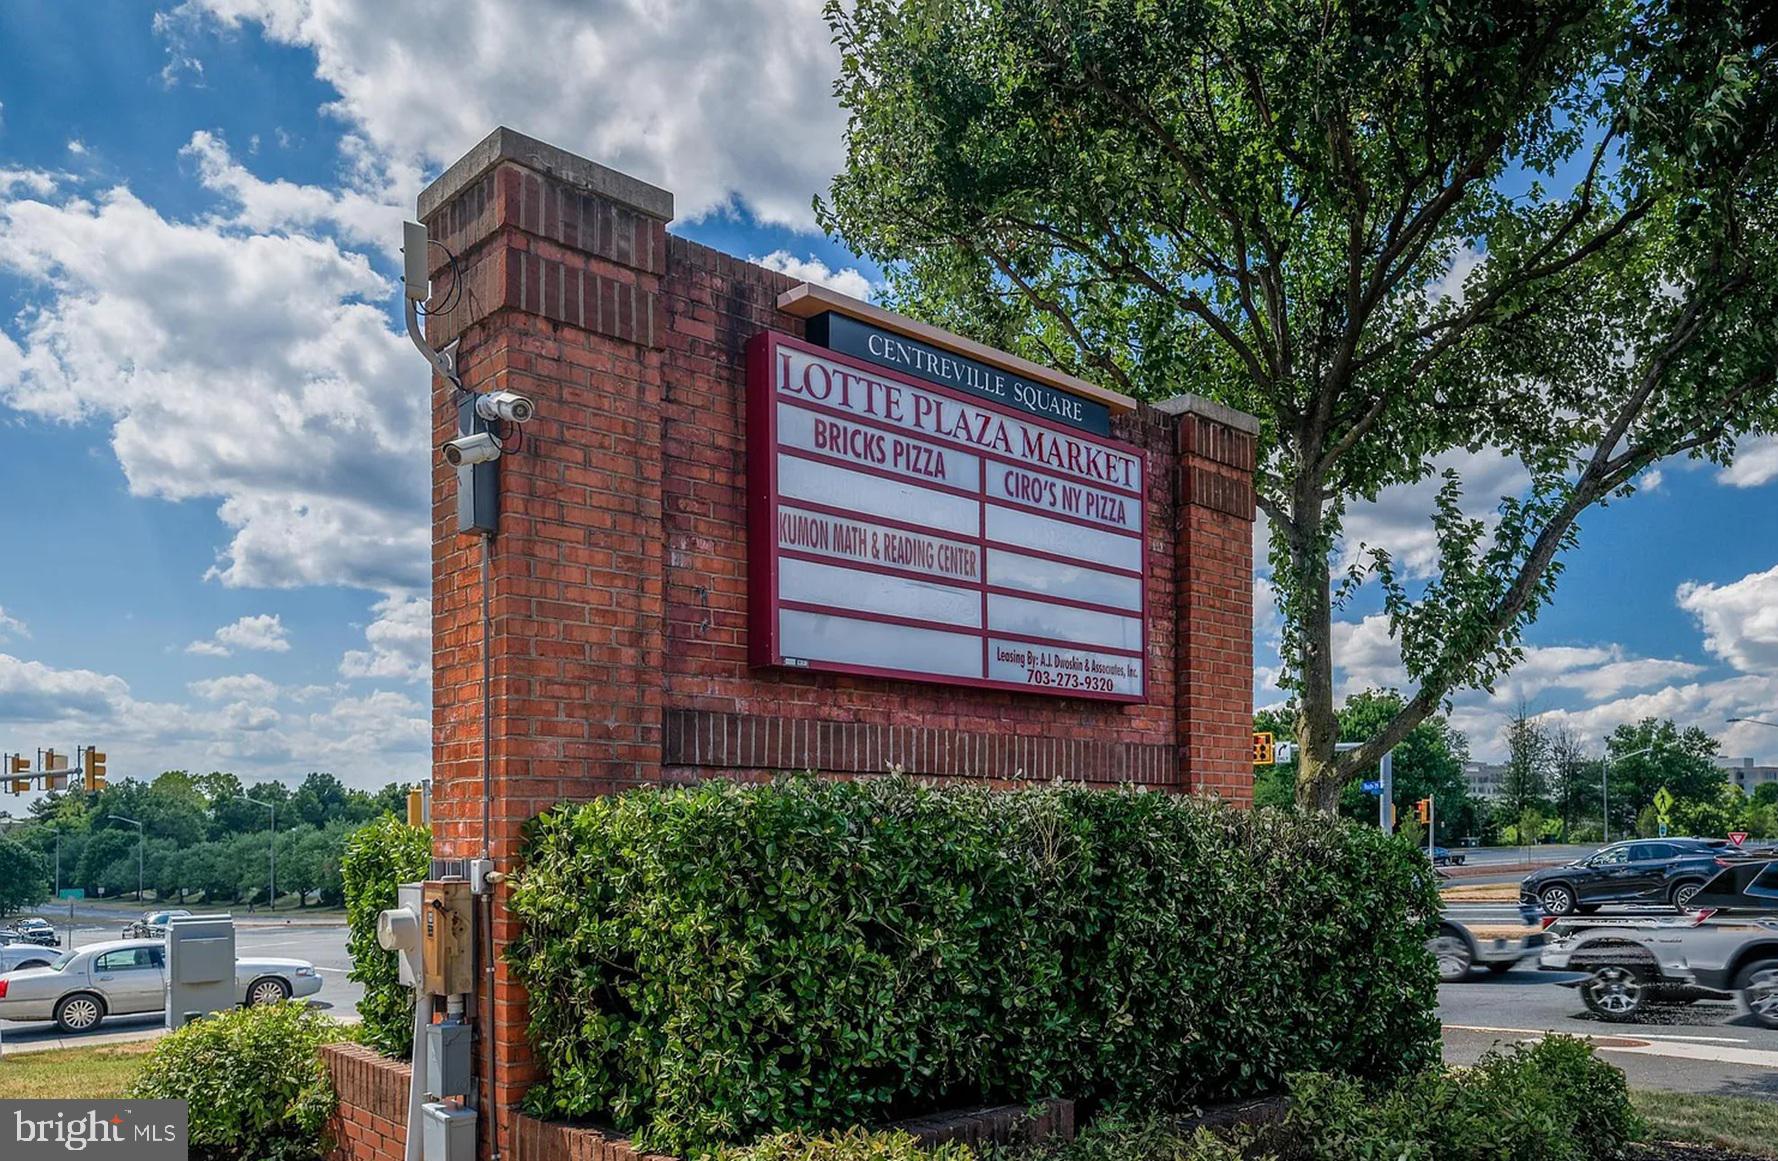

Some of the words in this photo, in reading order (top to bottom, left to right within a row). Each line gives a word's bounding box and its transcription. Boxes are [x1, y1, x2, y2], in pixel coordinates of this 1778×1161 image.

[868, 334, 1005, 397] CENTREVILLE
[1014, 382, 1083, 422] SQUARE
[779, 352, 904, 422] LOTTE
[912, 392, 1014, 455] PLAZA
[1019, 425, 1136, 488] MARKET
[814, 417, 887, 465] BRICKS
[893, 439, 946, 480] PIZZA
[1004, 470, 1057, 507] CIRO'S
[1062, 484, 1082, 514] NY
[1086, 491, 1127, 525] PIZZA
[779, 511, 829, 551] KUMON
[833, 522, 867, 558] MATH
[871, 531, 881, 561] &
[884, 532, 934, 570] READING
[937, 543, 977, 578] CENTER
[997, 646, 1025, 668] Leasing
[1027, 650, 1039, 668] By:
[1054, 654, 1083, 671] Dwoskin
[1084, 658, 1090, 672] &
[1091, 660, 1126, 679] Associates,
[1127, 664, 1139, 679] Inc.
[1027, 669, 1114, 692] 703-273-9320
